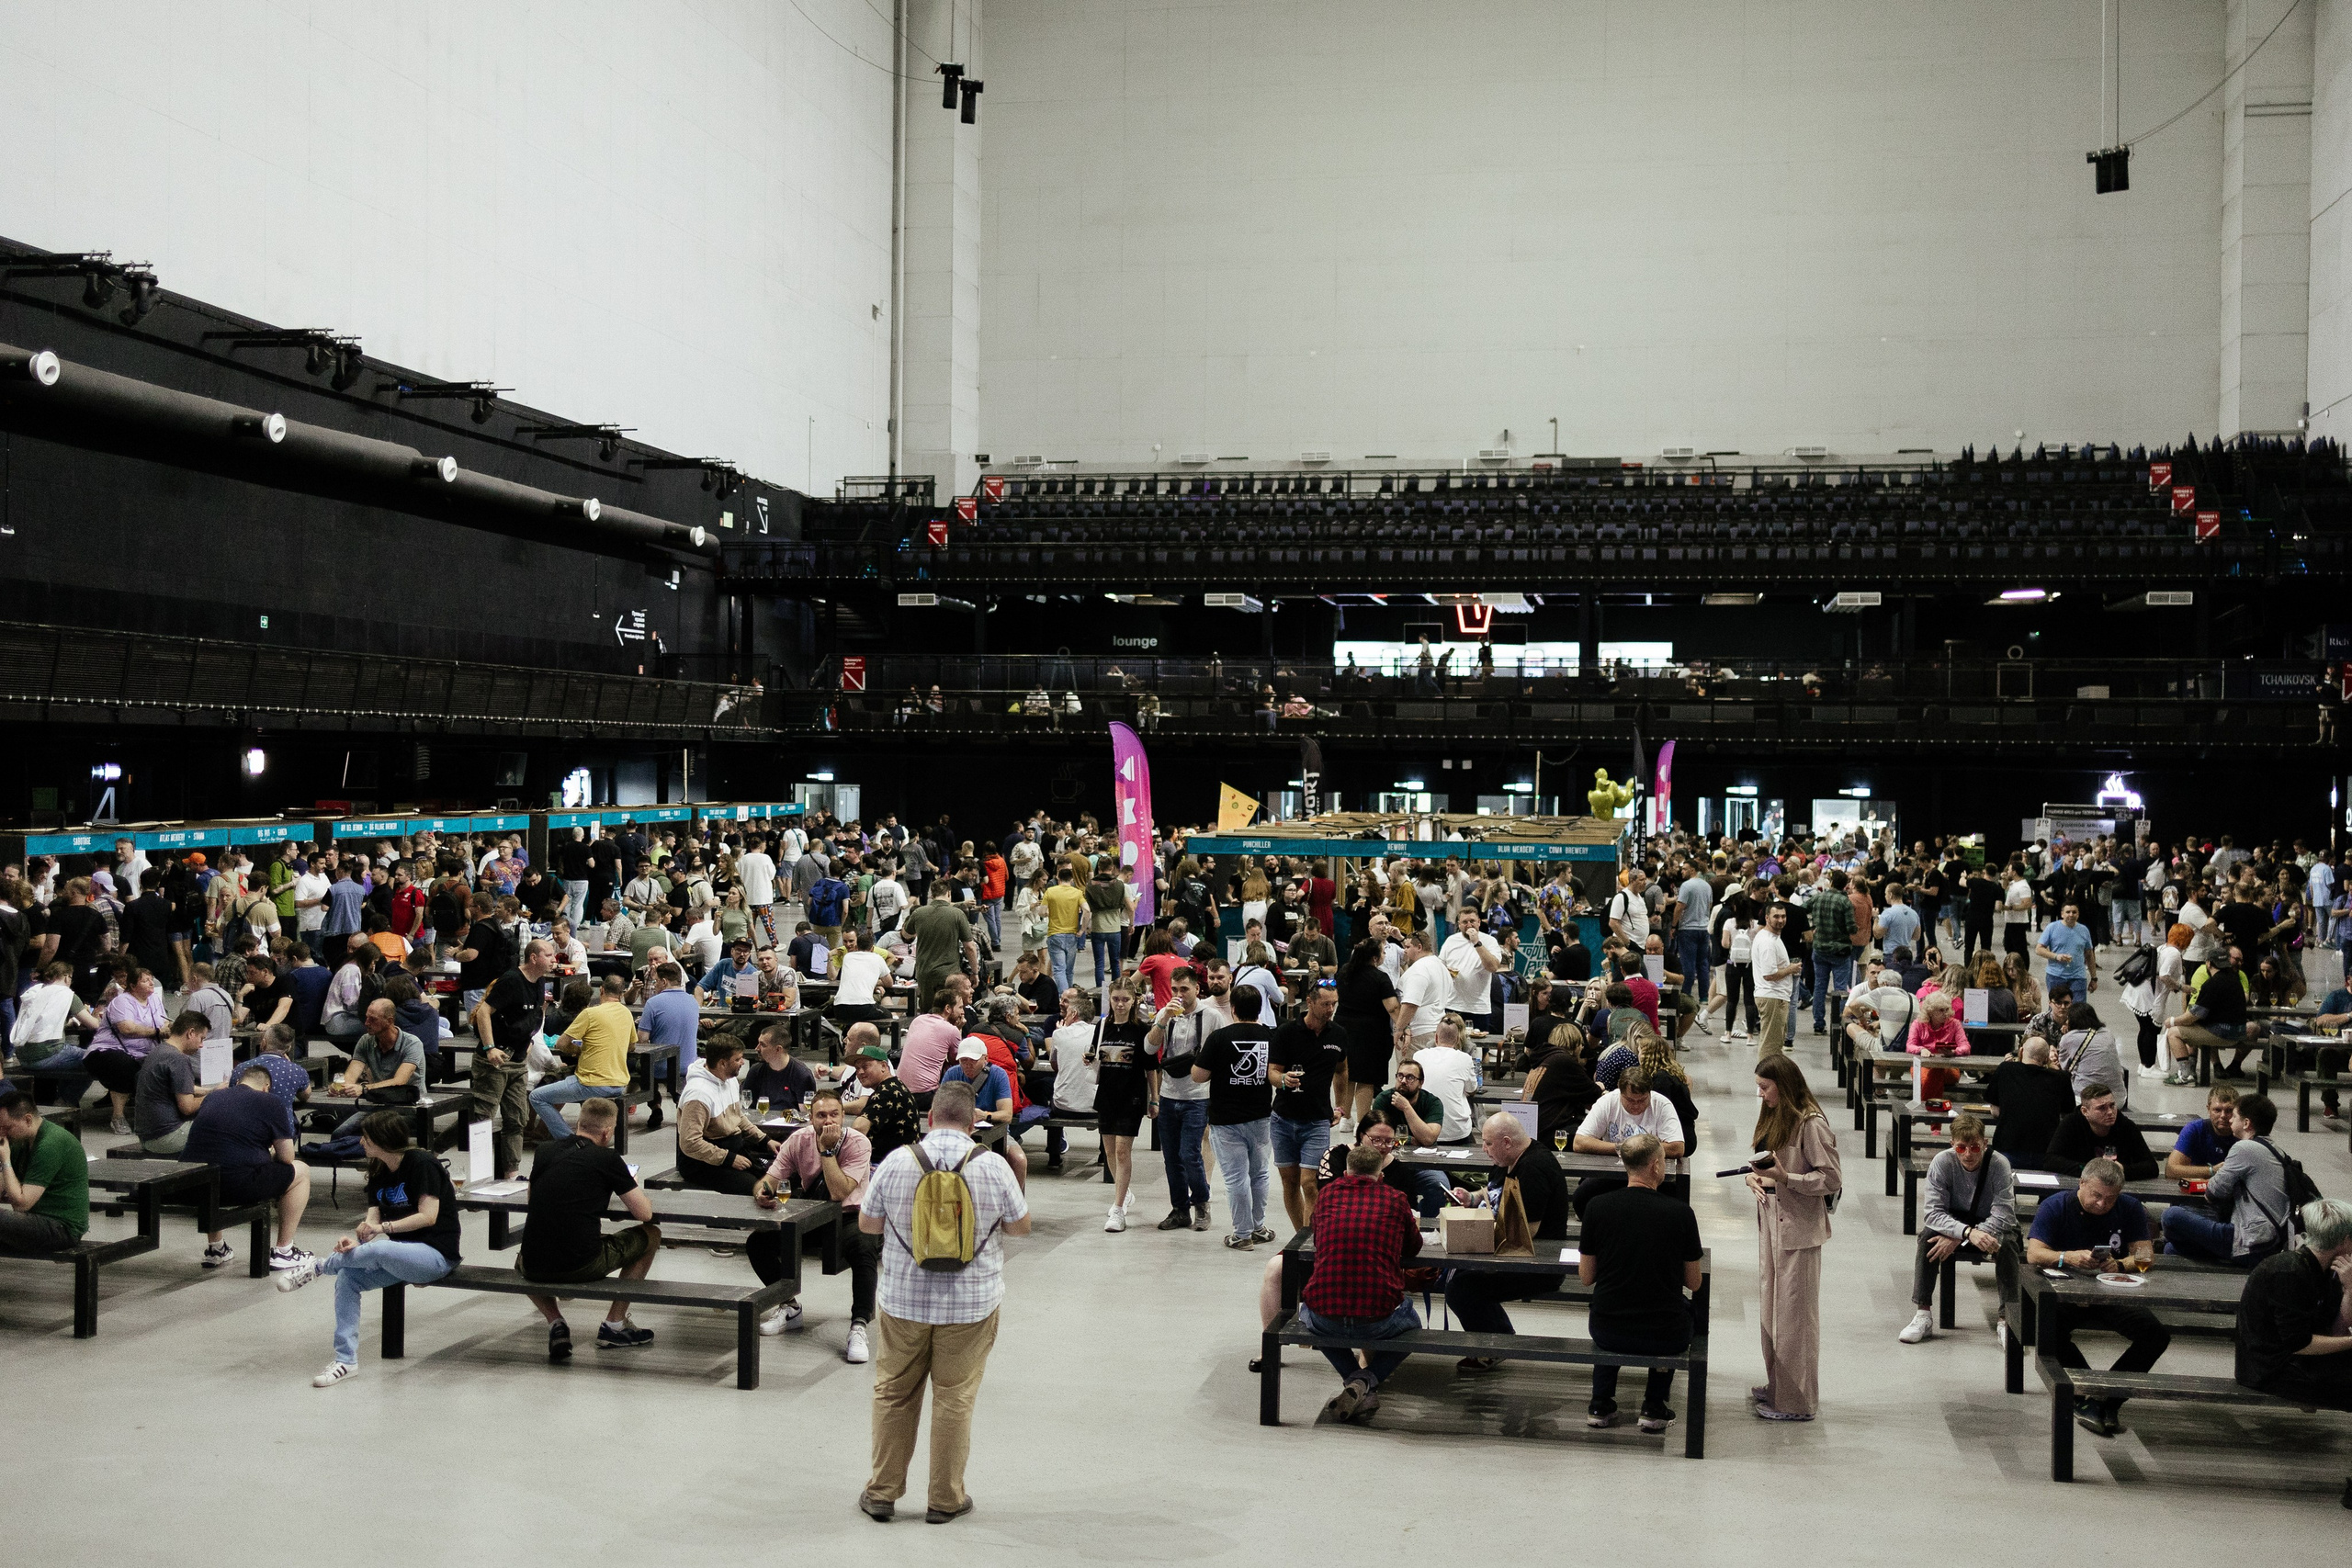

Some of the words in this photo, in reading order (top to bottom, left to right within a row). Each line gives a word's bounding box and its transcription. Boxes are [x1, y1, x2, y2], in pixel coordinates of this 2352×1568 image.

[1113, 635, 1158, 649] lounge
[2329, 637, 2349, 646] Rich
[2260, 674, 2318, 685] TCHAIKOVSK
[92, 786, 119, 825] 4
[1498, 845, 1510, 853] BLUR
[1511, 845, 1535, 853] MEADERY
[1548, 846, 1563, 854] COMA
[1258, 1043, 1268, 1077] STATE
